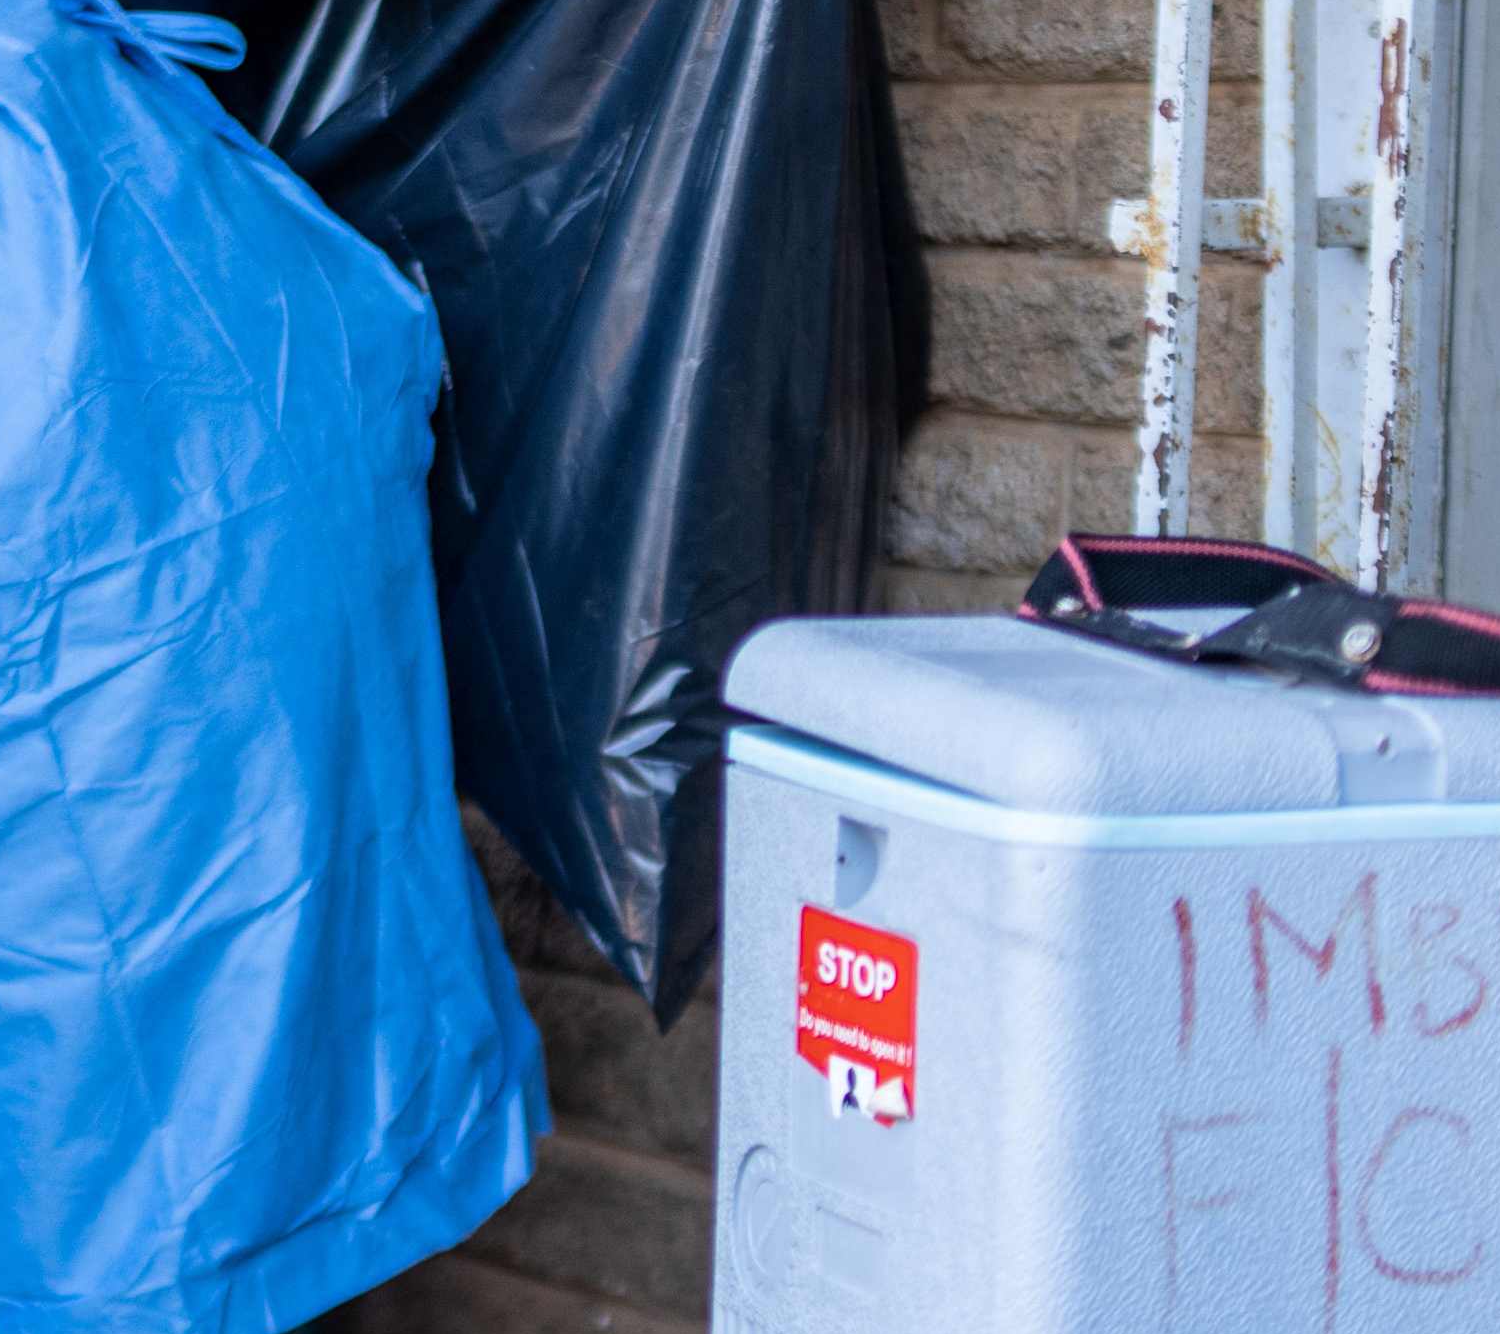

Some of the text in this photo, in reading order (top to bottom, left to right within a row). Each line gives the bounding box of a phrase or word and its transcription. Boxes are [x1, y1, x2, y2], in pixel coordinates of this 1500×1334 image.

[819, 942, 896, 1001] STOP
[814, 1017, 833, 1037] you
[833, 1024, 858, 1048] need
[858, 1028, 871, 1052] to
[871, 1038, 896, 1061] open
